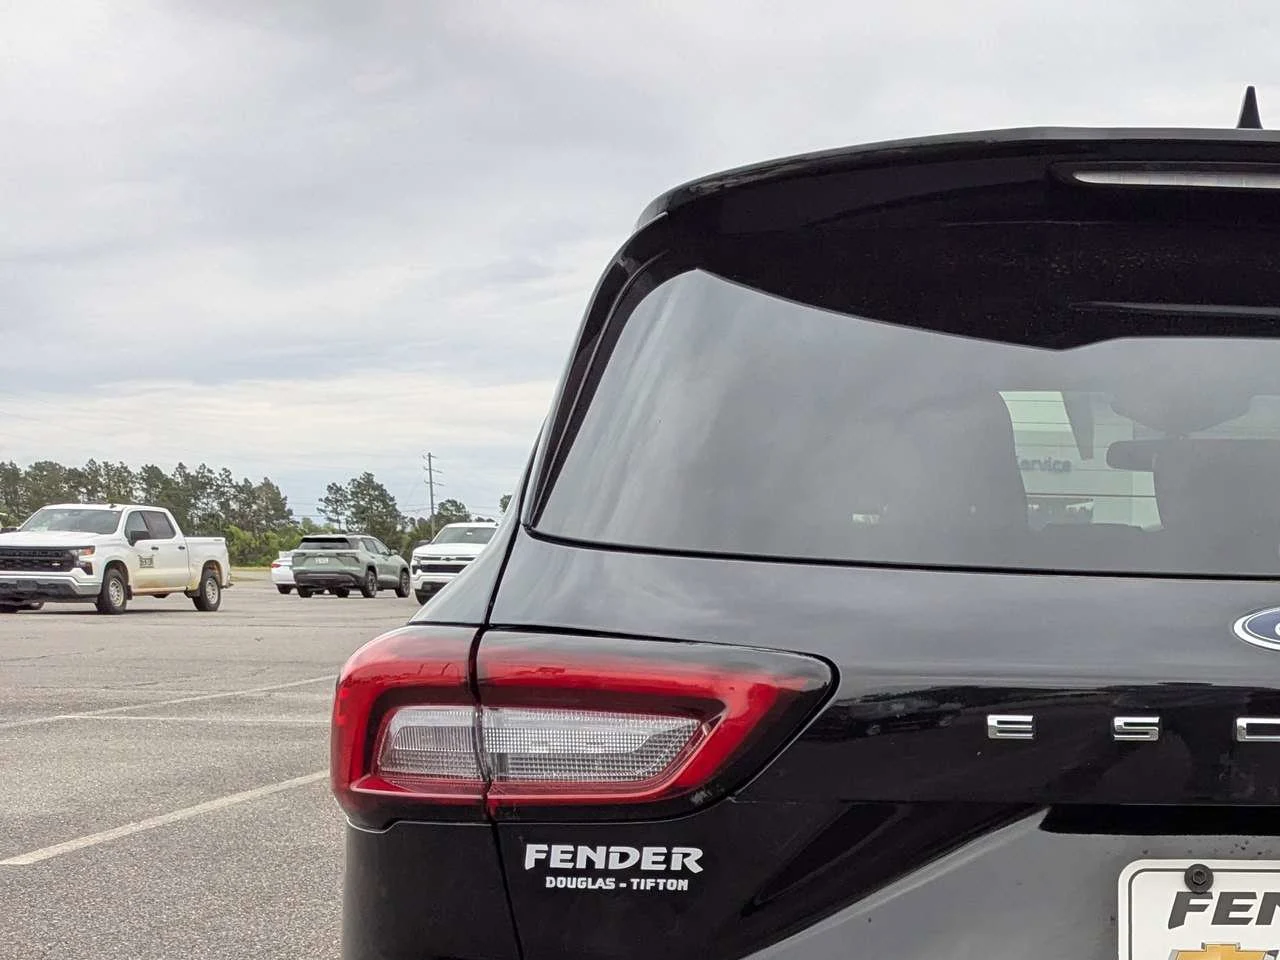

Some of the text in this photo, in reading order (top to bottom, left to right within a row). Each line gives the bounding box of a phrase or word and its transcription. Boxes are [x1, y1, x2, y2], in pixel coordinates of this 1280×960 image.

[525, 844, 704, 873] FENDER
[546, 877, 615, 890] DOUGLAS
[630, 878, 689, 891] TIFTON
